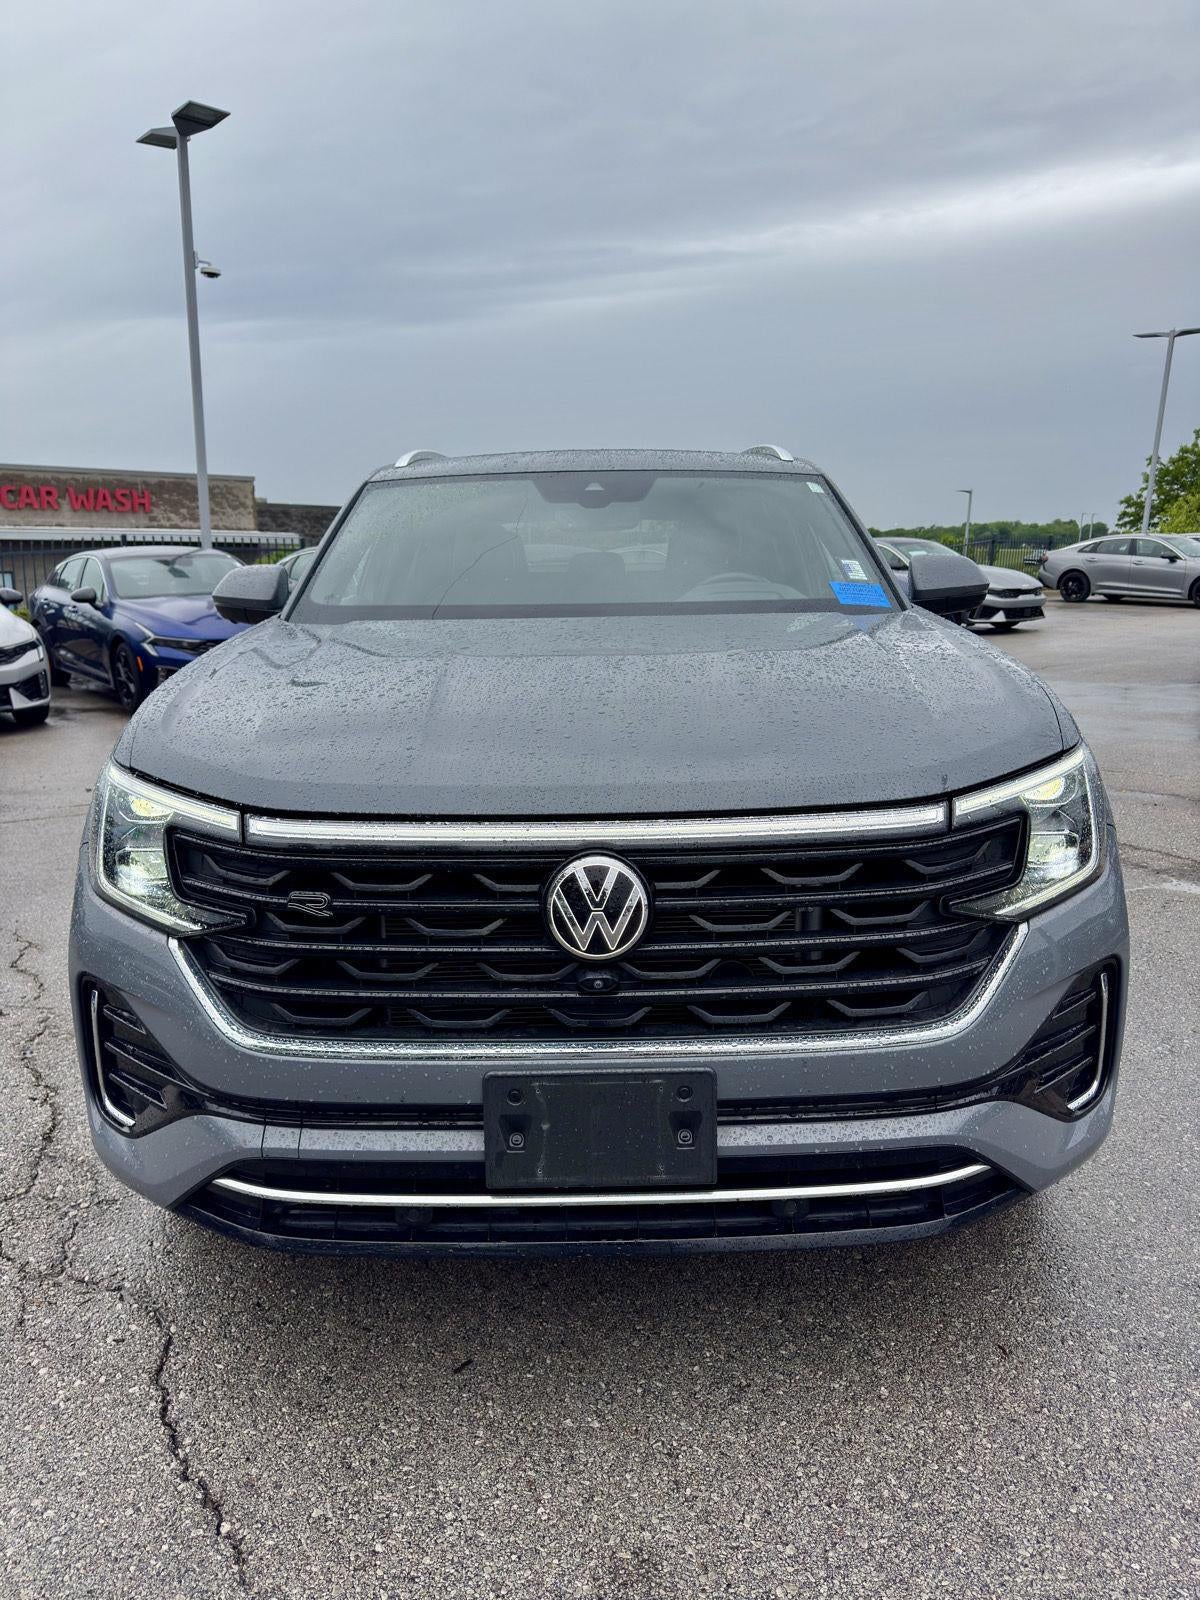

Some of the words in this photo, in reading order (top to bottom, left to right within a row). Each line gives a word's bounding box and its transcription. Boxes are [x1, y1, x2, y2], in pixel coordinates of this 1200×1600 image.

[0, 484, 59, 510] CAR
[66, 485, 152, 513] WASH
[553, 864, 642, 952] VW
